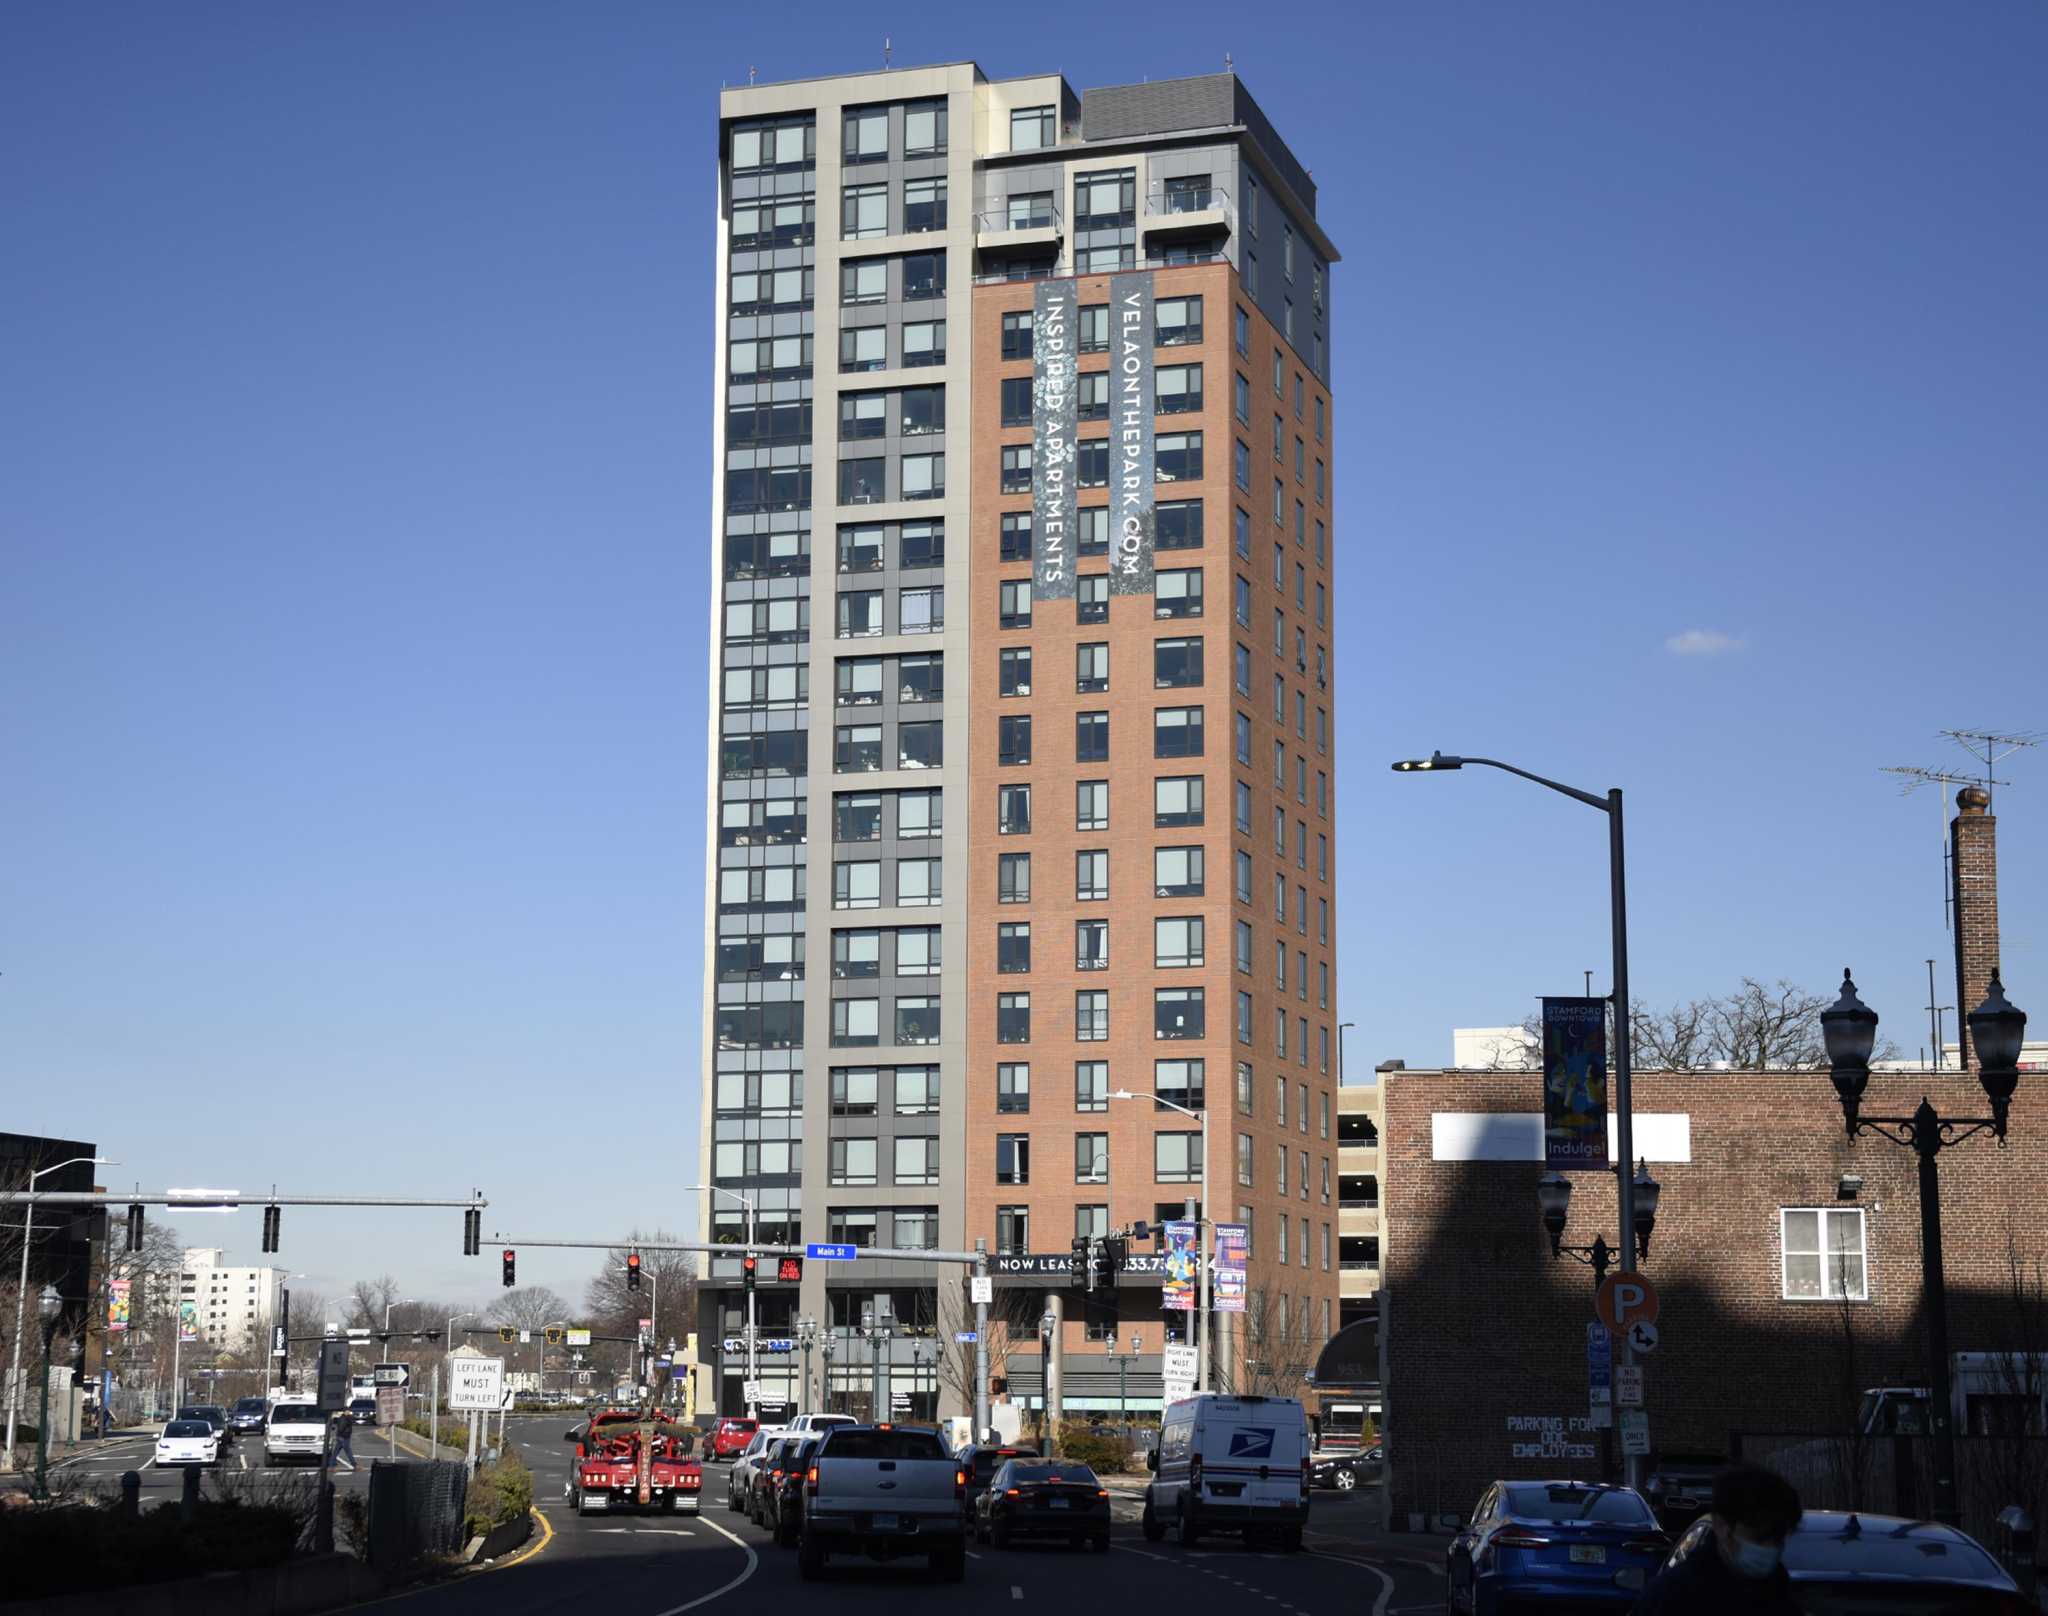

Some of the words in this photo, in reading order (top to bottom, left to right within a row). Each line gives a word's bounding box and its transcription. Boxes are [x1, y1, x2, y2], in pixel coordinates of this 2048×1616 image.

[1046, 297, 1064, 411] INSPIRED
[1123, 293, 1141, 574] VELAONTHEPARK.COM
[1045, 421, 1063, 581] APARTMENTS
[1546, 1006, 1601, 1015] STAMFORD
[1548, 1015, 1600, 1024] DOWNTOWN
[1549, 1140, 1605, 1157] Indulge!
[817, 1247, 835, 1256] Main
[837, 1247, 845, 1256] St
[1000, 1259, 1035, 1270] NOW
[1615, 1284, 1645, 1325] P
[457, 1364, 475, 1372] LEFT
[478, 1365, 497, 1373] LANE
[464, 1379, 489, 1388] MUST
[455, 1393, 475, 1401] TURN
[477, 1394, 496, 1402] LEFT
[746, 1391, 759, 1400] 25
[1507, 1416, 1563, 1431] PARKING
[1512, 1443, 1595, 1458] EMPLOYEES
